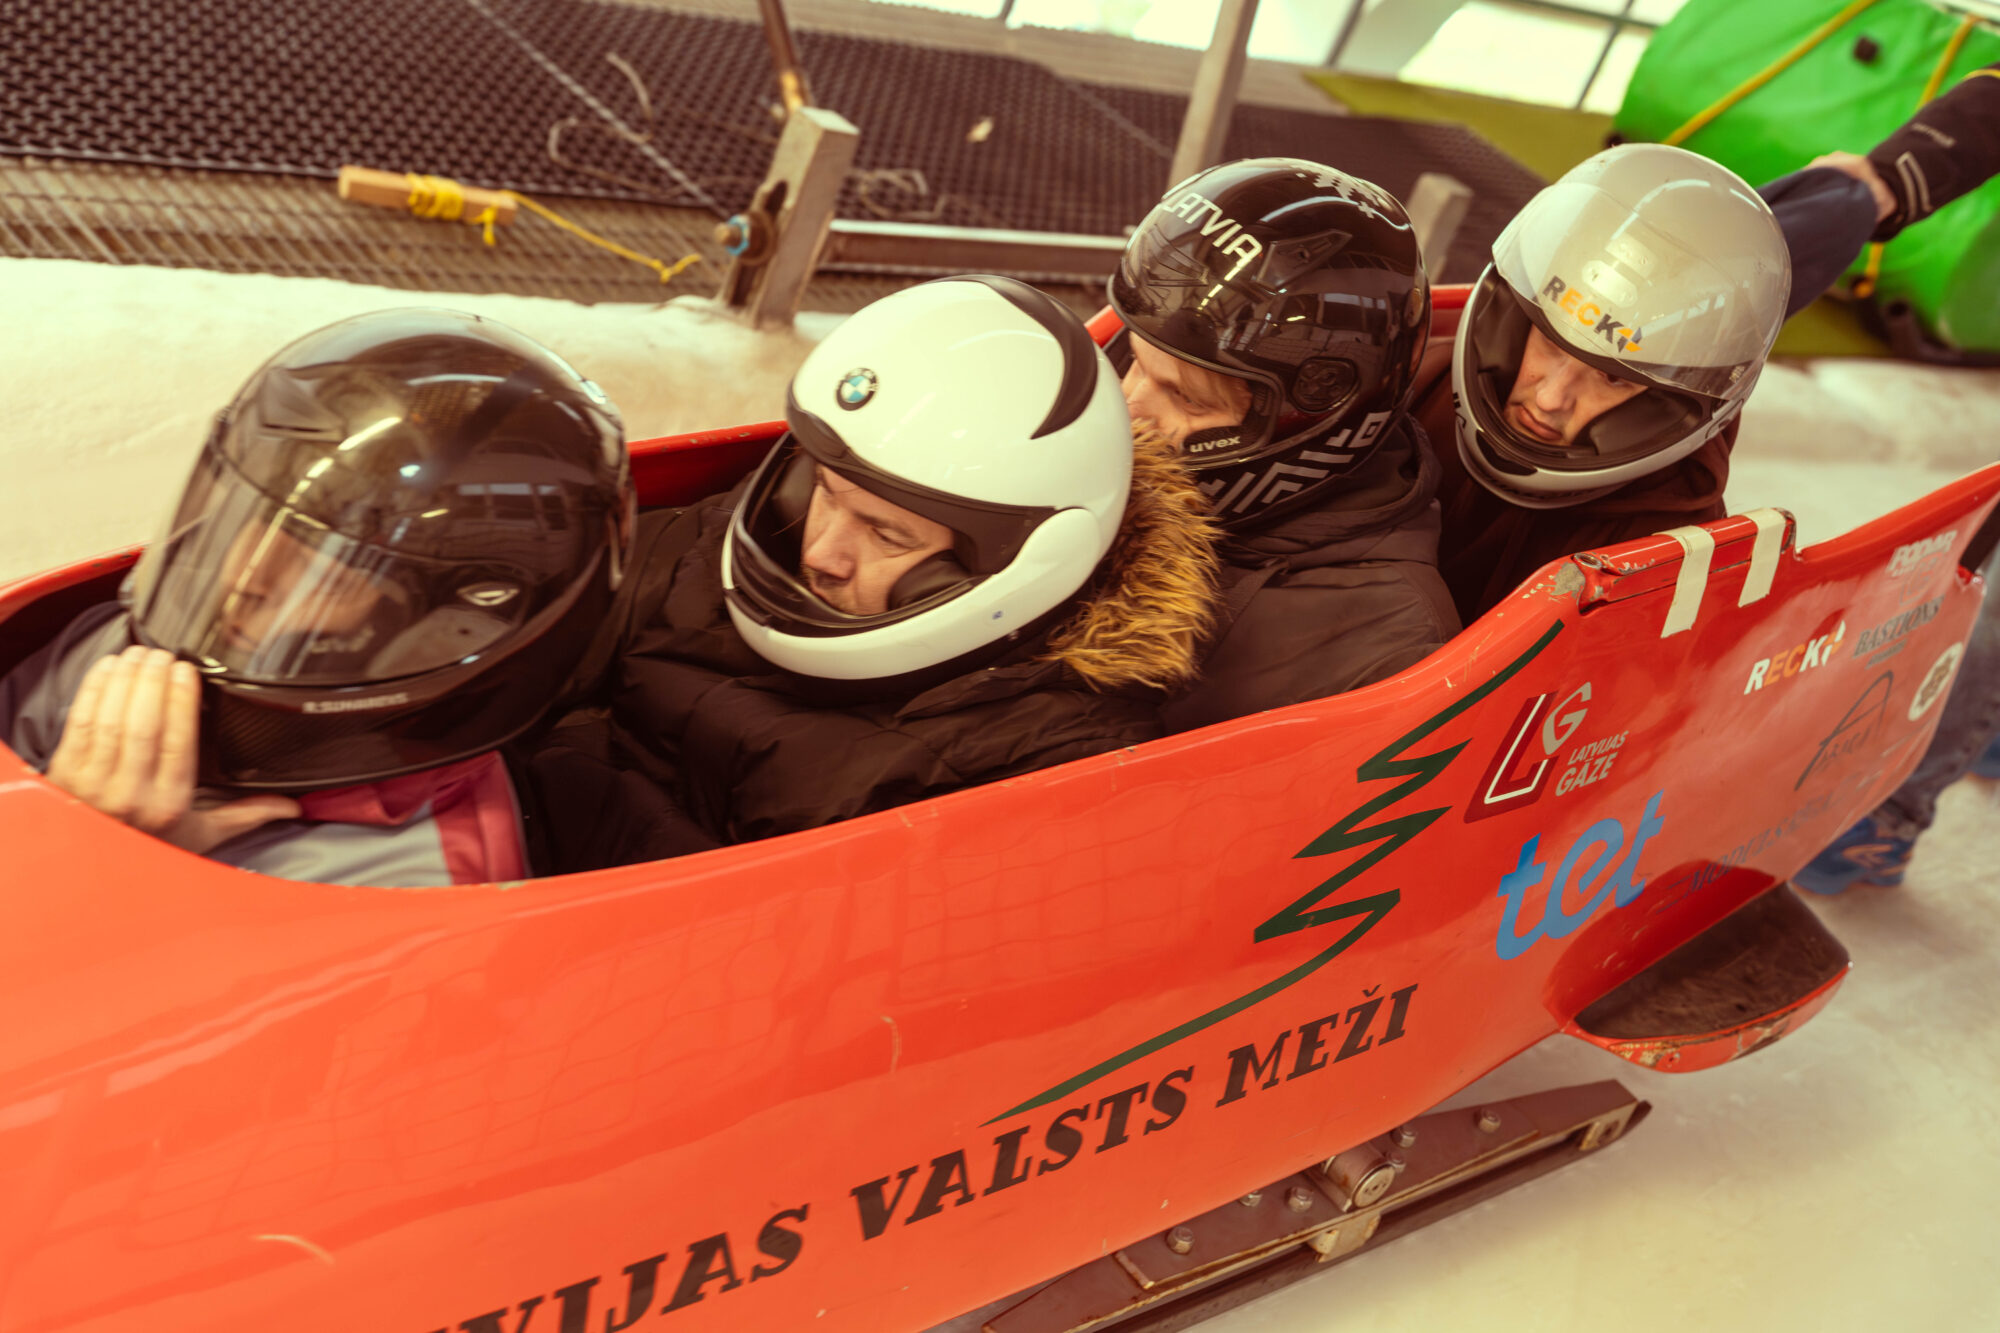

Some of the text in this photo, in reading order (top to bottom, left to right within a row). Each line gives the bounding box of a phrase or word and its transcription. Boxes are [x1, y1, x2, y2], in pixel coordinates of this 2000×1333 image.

[1159, 190, 1262, 266] LATVIA
[1190, 436, 1240, 453] uvex
[1496, 788, 1666, 960] tet
[425, 984, 1418, 1333] VIJAS VALSTS MEŽI
